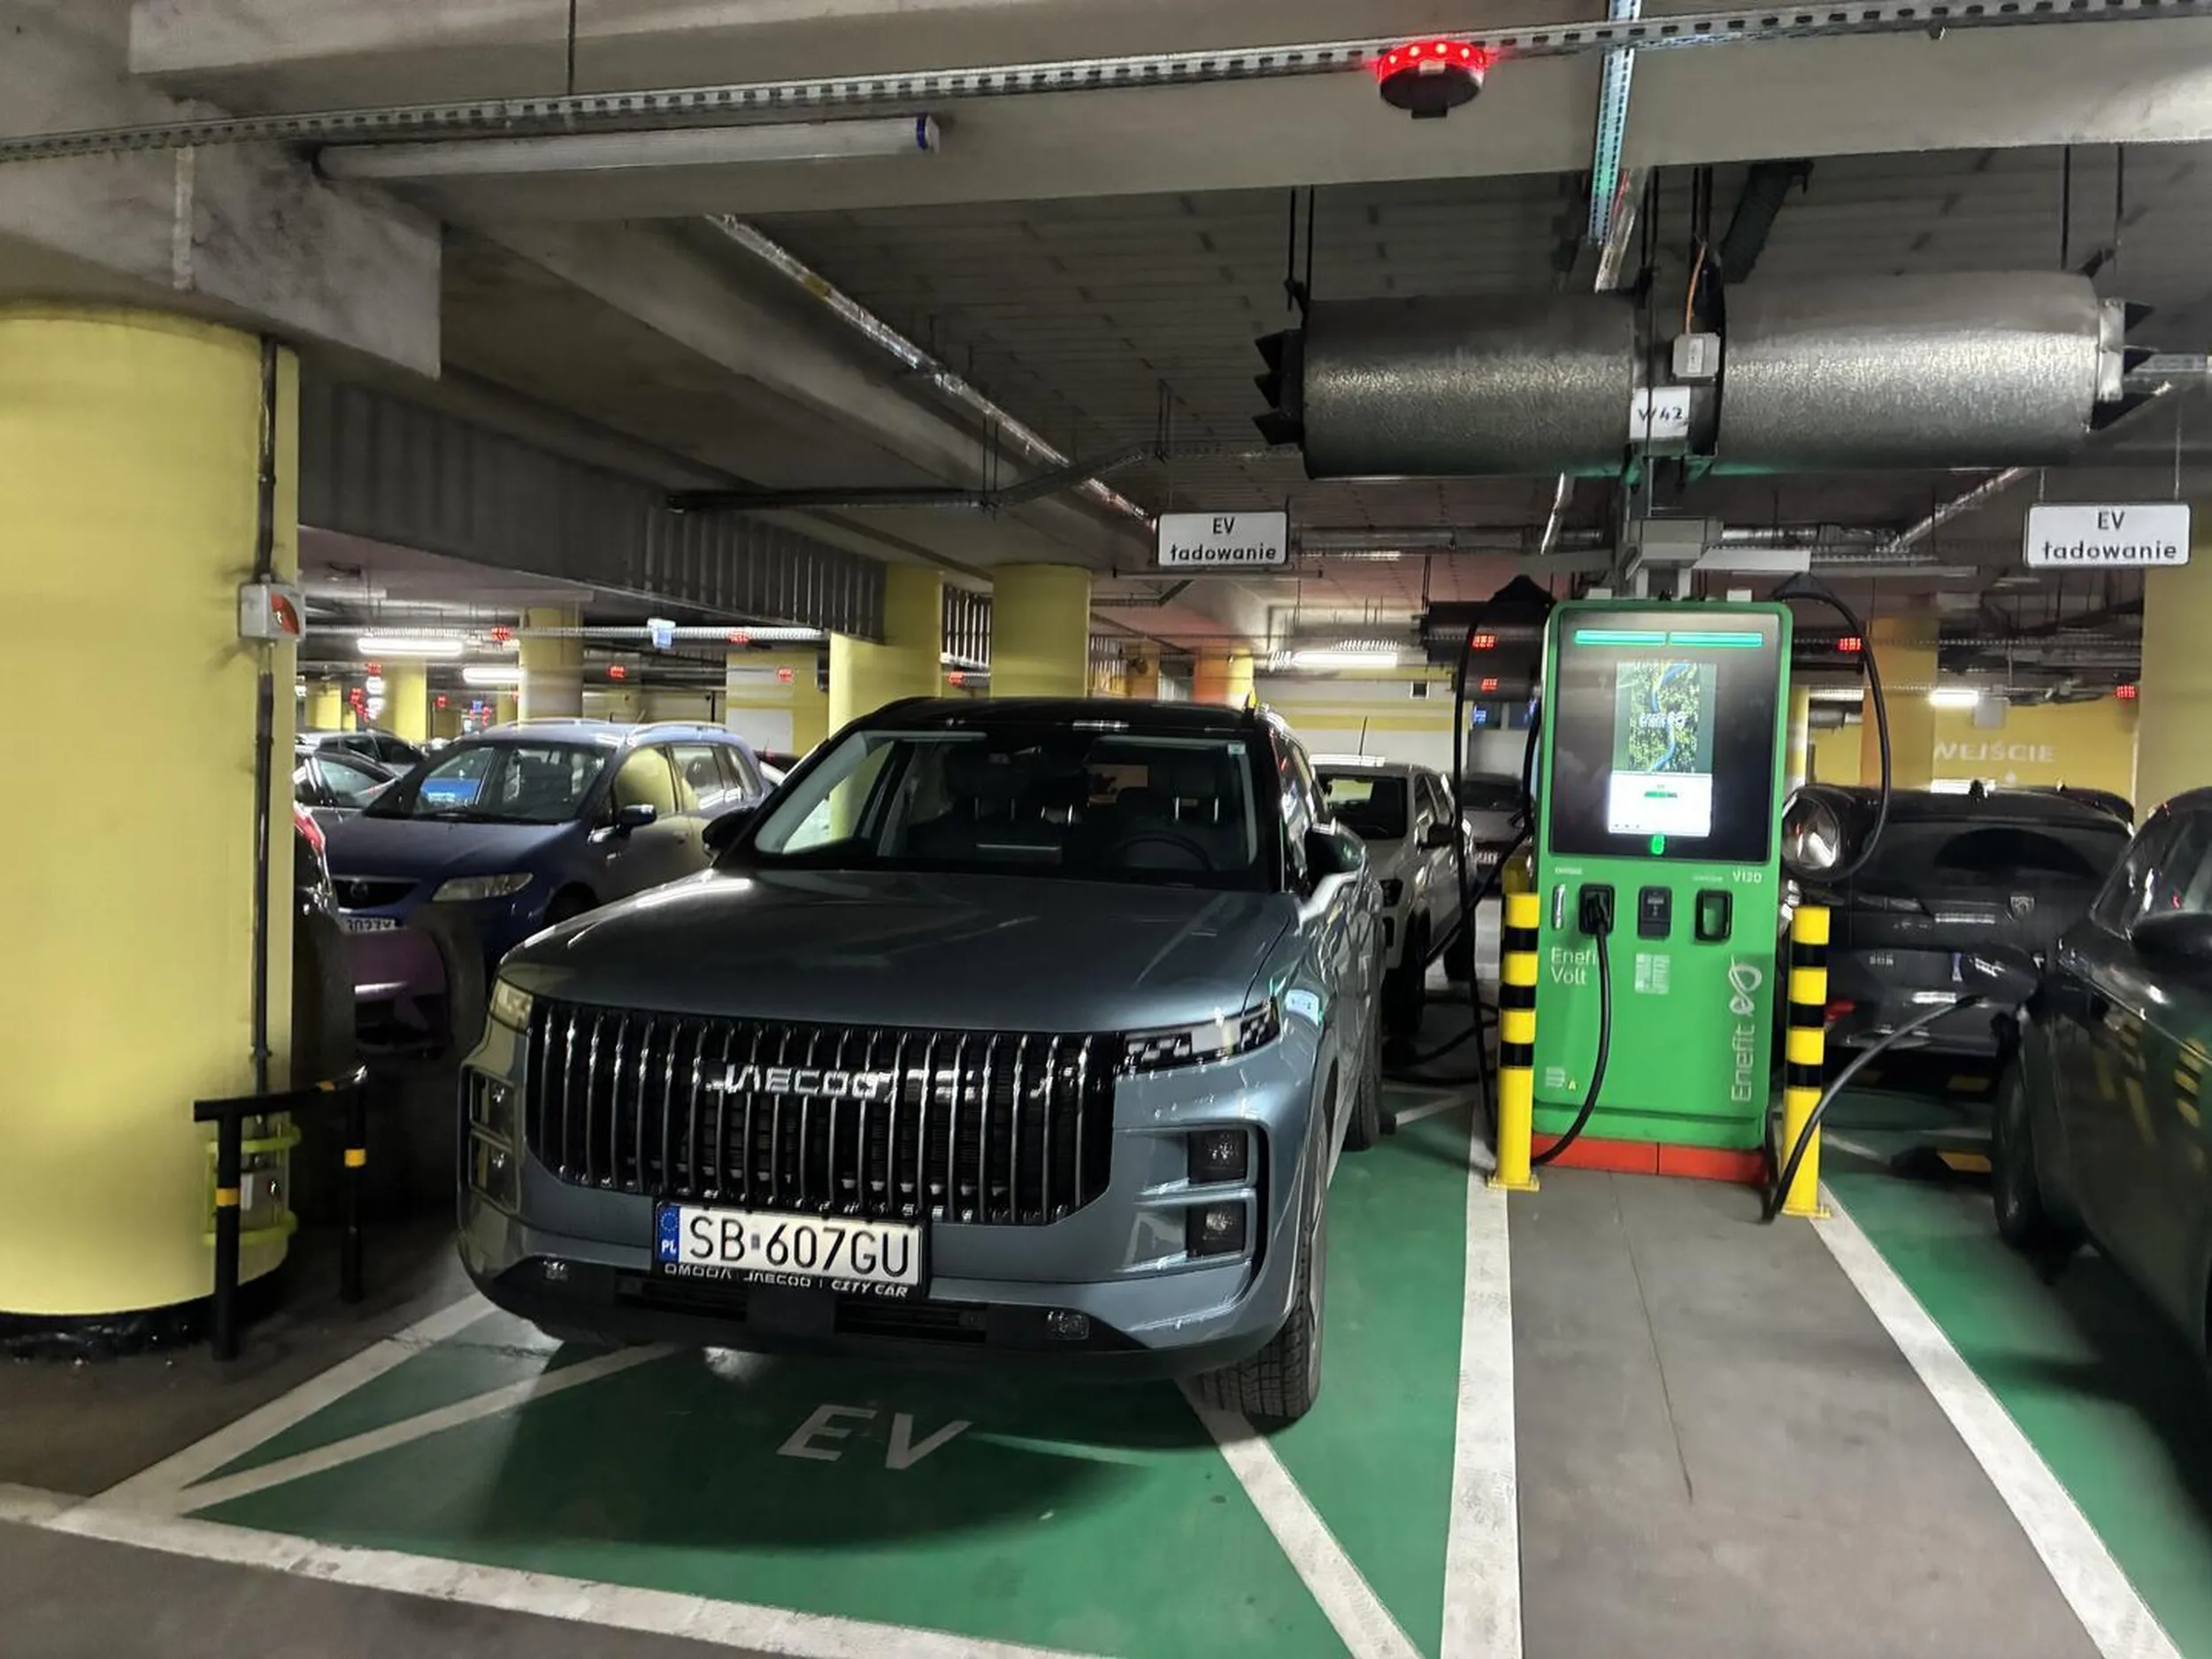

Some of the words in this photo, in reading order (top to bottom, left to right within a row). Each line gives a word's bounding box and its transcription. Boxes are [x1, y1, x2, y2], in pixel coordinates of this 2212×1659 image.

[1212, 517, 1235, 534] EV
[2098, 511, 2126, 530] EV
[1170, 543, 1277, 561] ładowanie
[2043, 541, 2177, 559] ładowanie
[1551, 947, 1598, 966] Enefi
[1551, 967, 1586, 986] Volt
[1731, 1023, 1755, 1102] Enefit
[662, 1240, 677, 1254] PL
[689, 1216, 745, 1262] SB
[765, 1224, 909, 1278] 607GU
[664, 1263, 732, 1279] OMODA
[743, 1271, 811, 1287] JAECOO
[832, 1279, 872, 1294] CITY
[874, 1284, 908, 1298] CAR
[776, 1404, 973, 1470] EV
